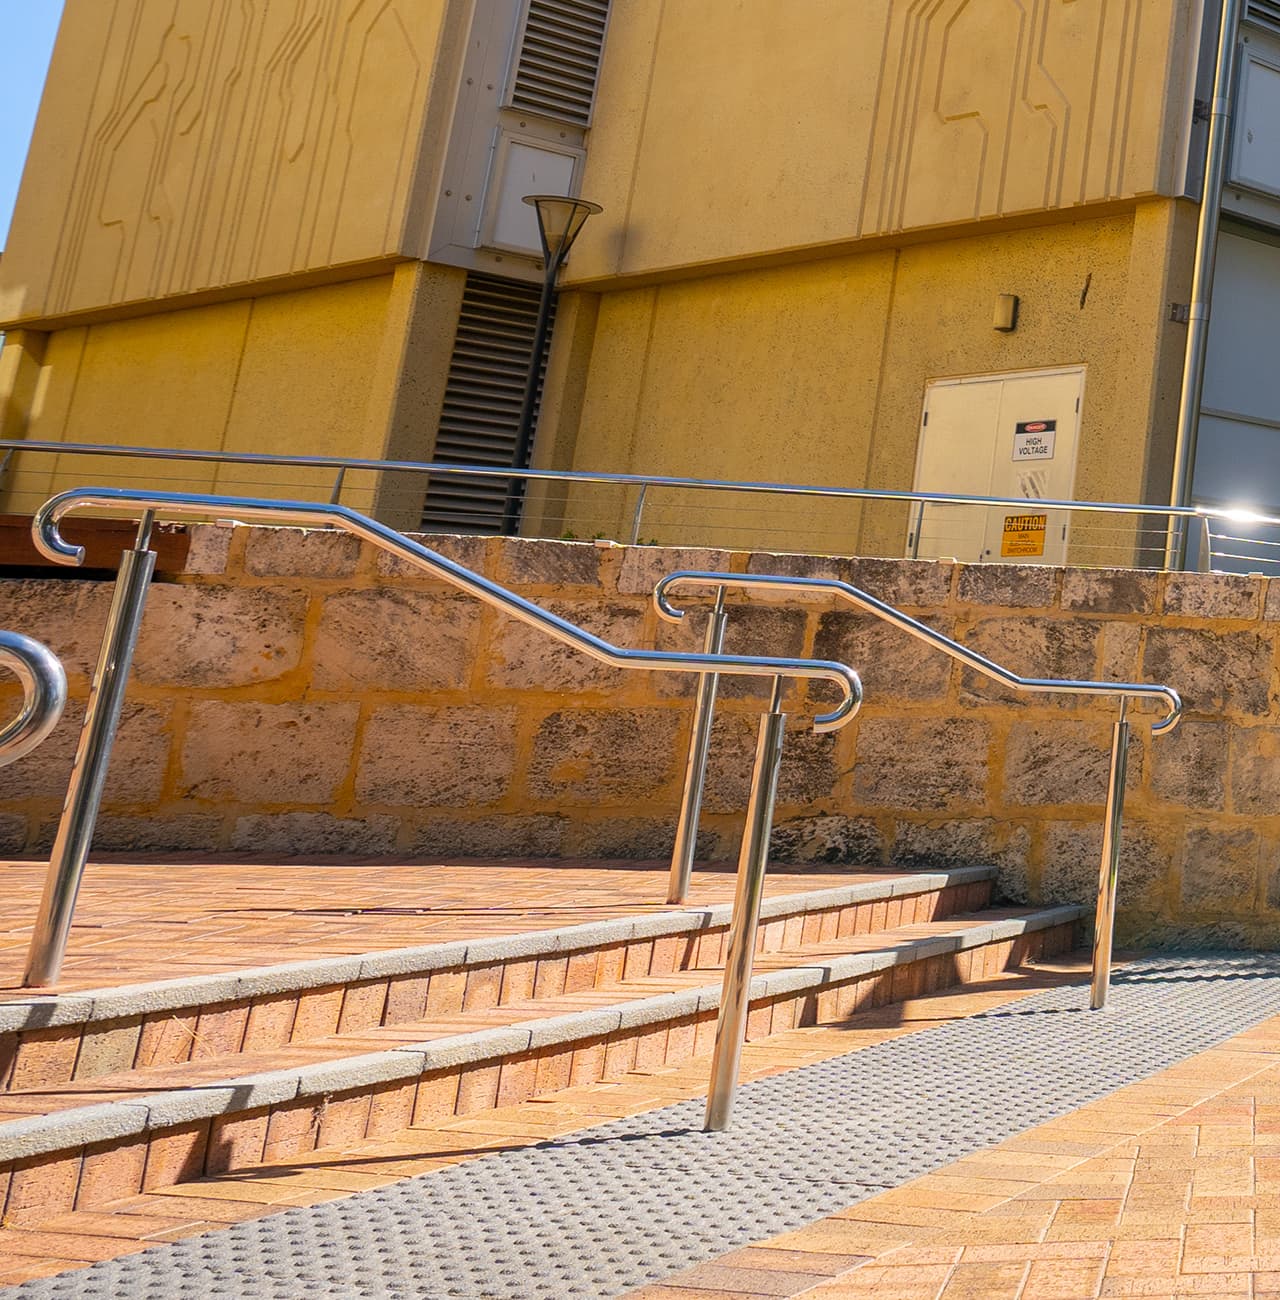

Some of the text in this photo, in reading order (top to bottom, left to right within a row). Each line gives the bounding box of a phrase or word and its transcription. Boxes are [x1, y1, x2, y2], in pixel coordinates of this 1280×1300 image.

[1025, 437, 1042, 446] HIGH
[1018, 445, 1048, 455] VOLTAGE
[1005, 516, 1046, 531] CAUTION
